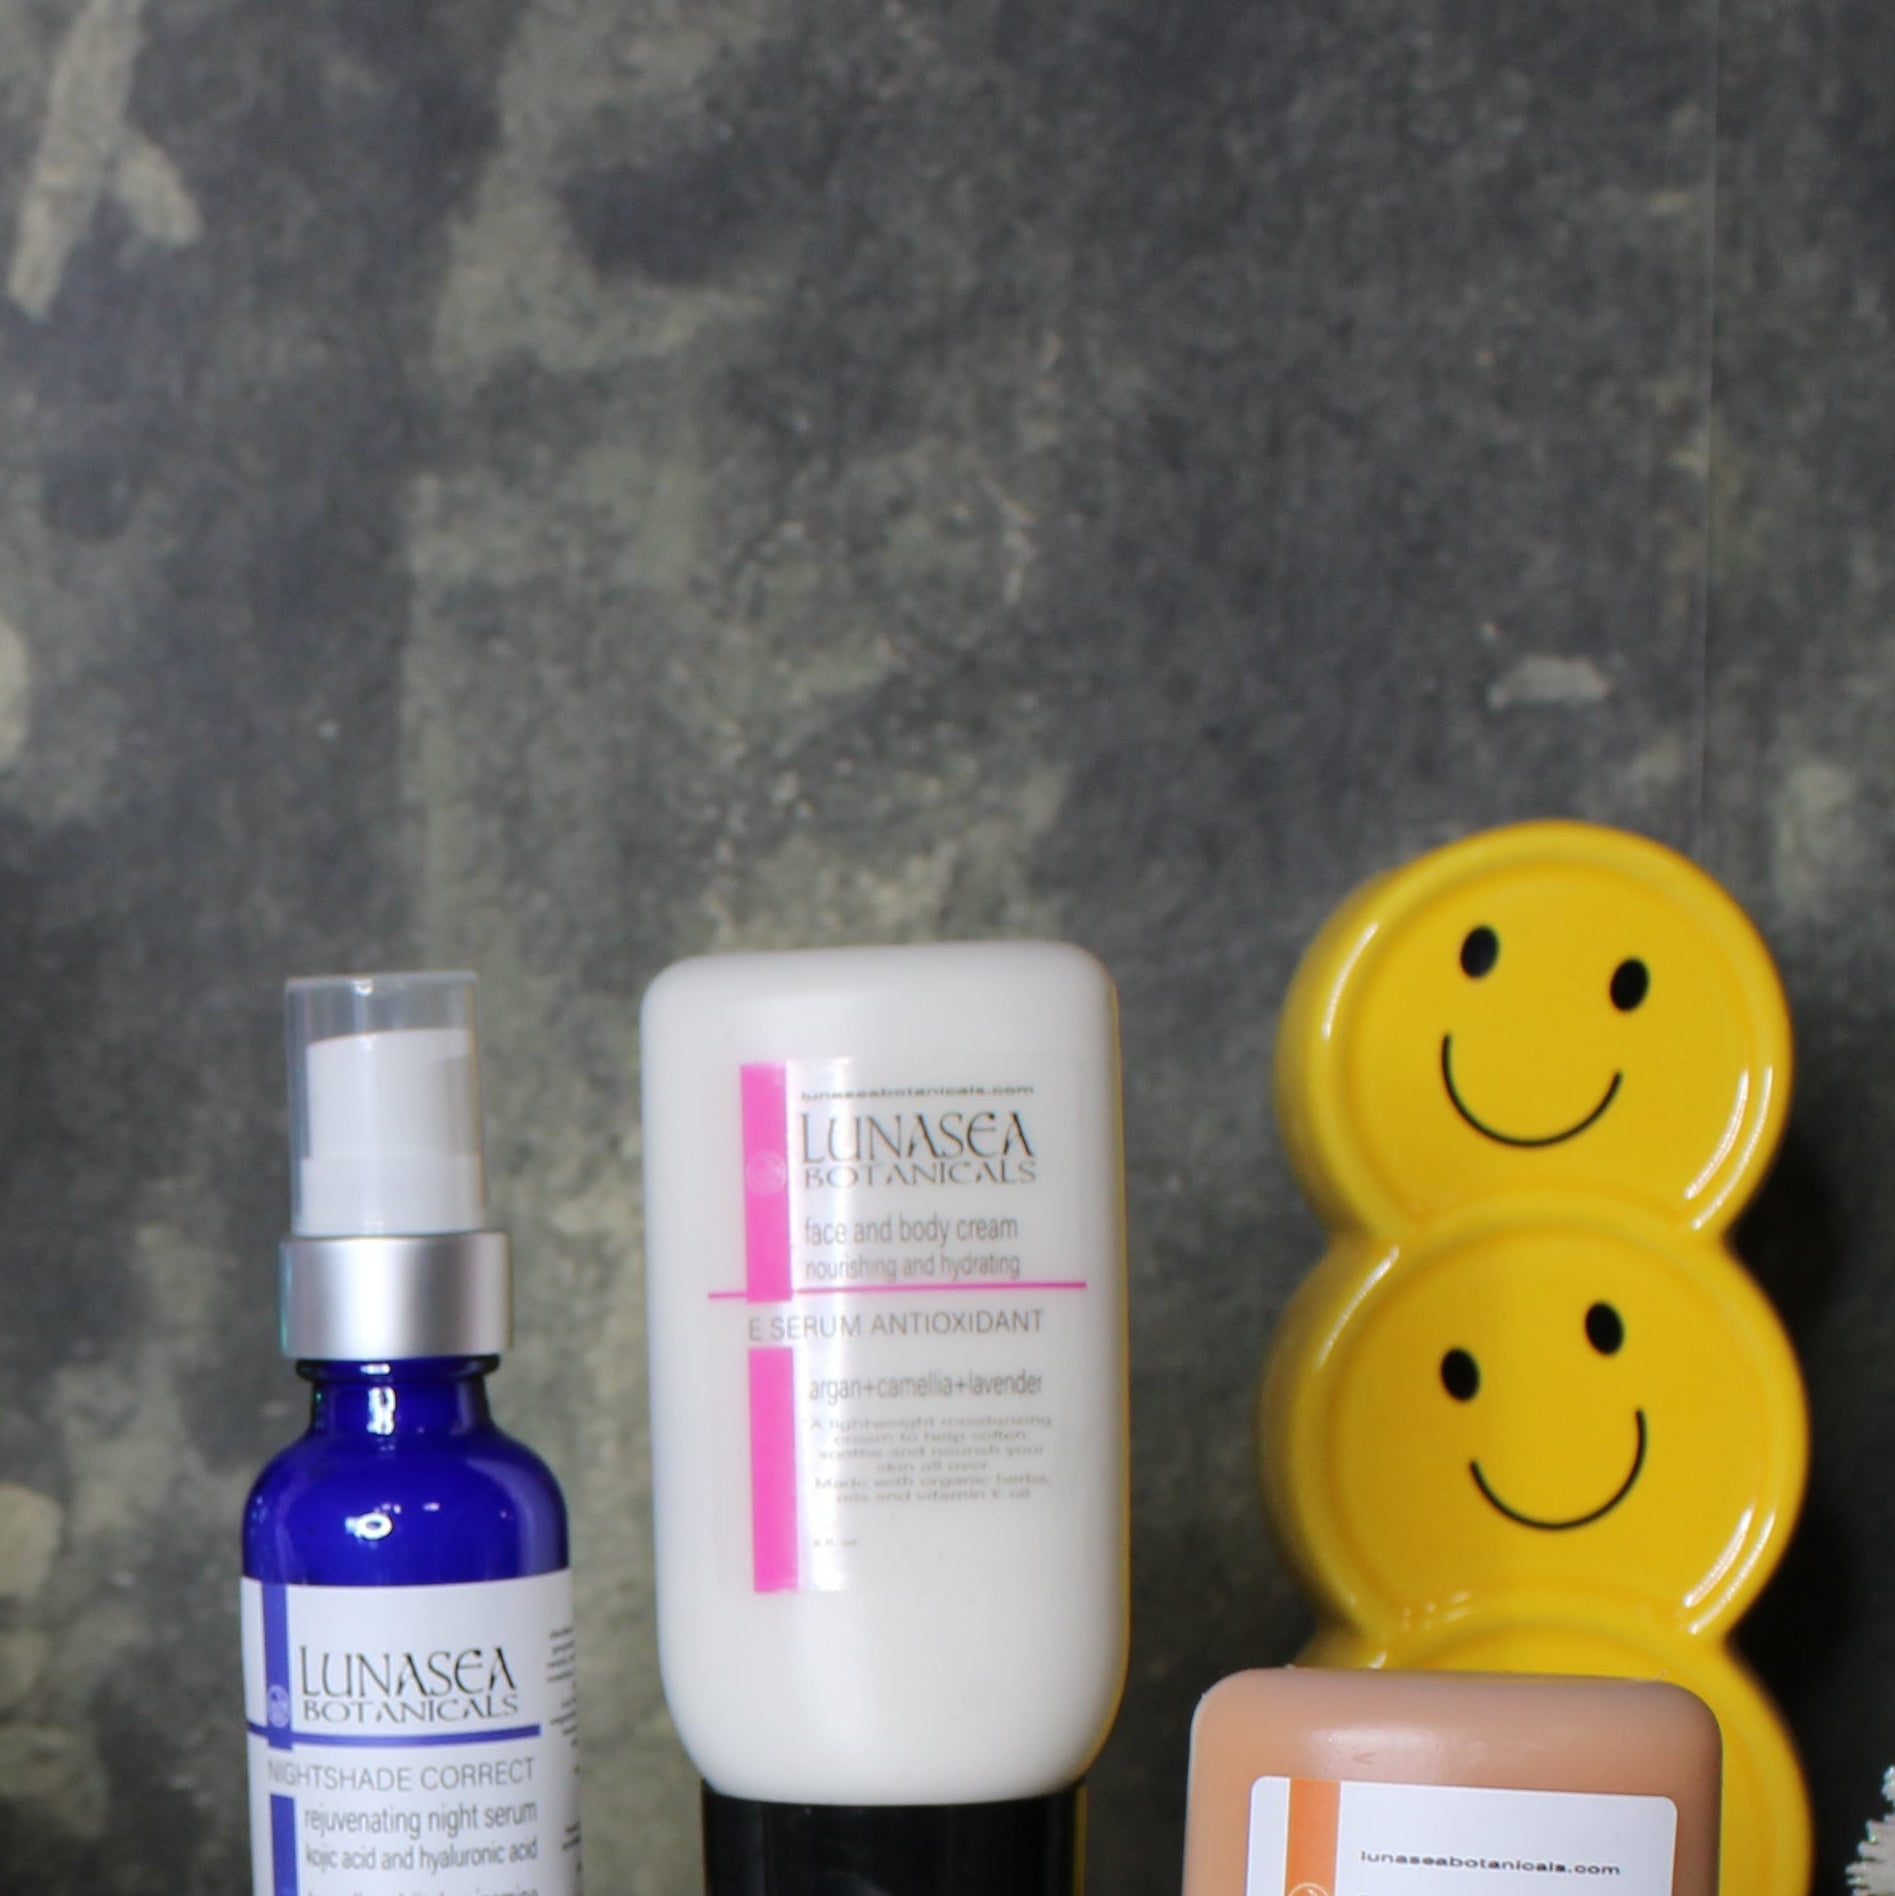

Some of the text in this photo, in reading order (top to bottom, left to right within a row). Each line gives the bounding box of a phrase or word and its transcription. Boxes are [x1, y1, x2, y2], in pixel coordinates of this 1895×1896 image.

[800, 1110, 1035, 1164] LUNASEA
[805, 1159, 1036, 1190] BOTANICALS
[805, 1211, 1019, 1247] face and body cream
[805, 1251, 1020, 1282] nourishing and hydrating
[748, 1309, 1044, 1341] E SERUM ANTIOXIDANT
[298, 1645, 516, 1698] LUNASEA
[303, 1694, 518, 1724] BOTANICALS
[267, 1756, 535, 1792] NIGHTSHADE CORRECT
[304, 1802, 538, 1840] rejuvenating night serum
[305, 1844, 337, 1874] kojic
[341, 1846, 376, 1870] acid
[380, 1845, 414, 1870] and
[419, 1841, 504, 1875] hyaluronic
[508, 1836, 538, 1862] acid
[1360, 1850, 1621, 1876] lunaseabotanicals.com
